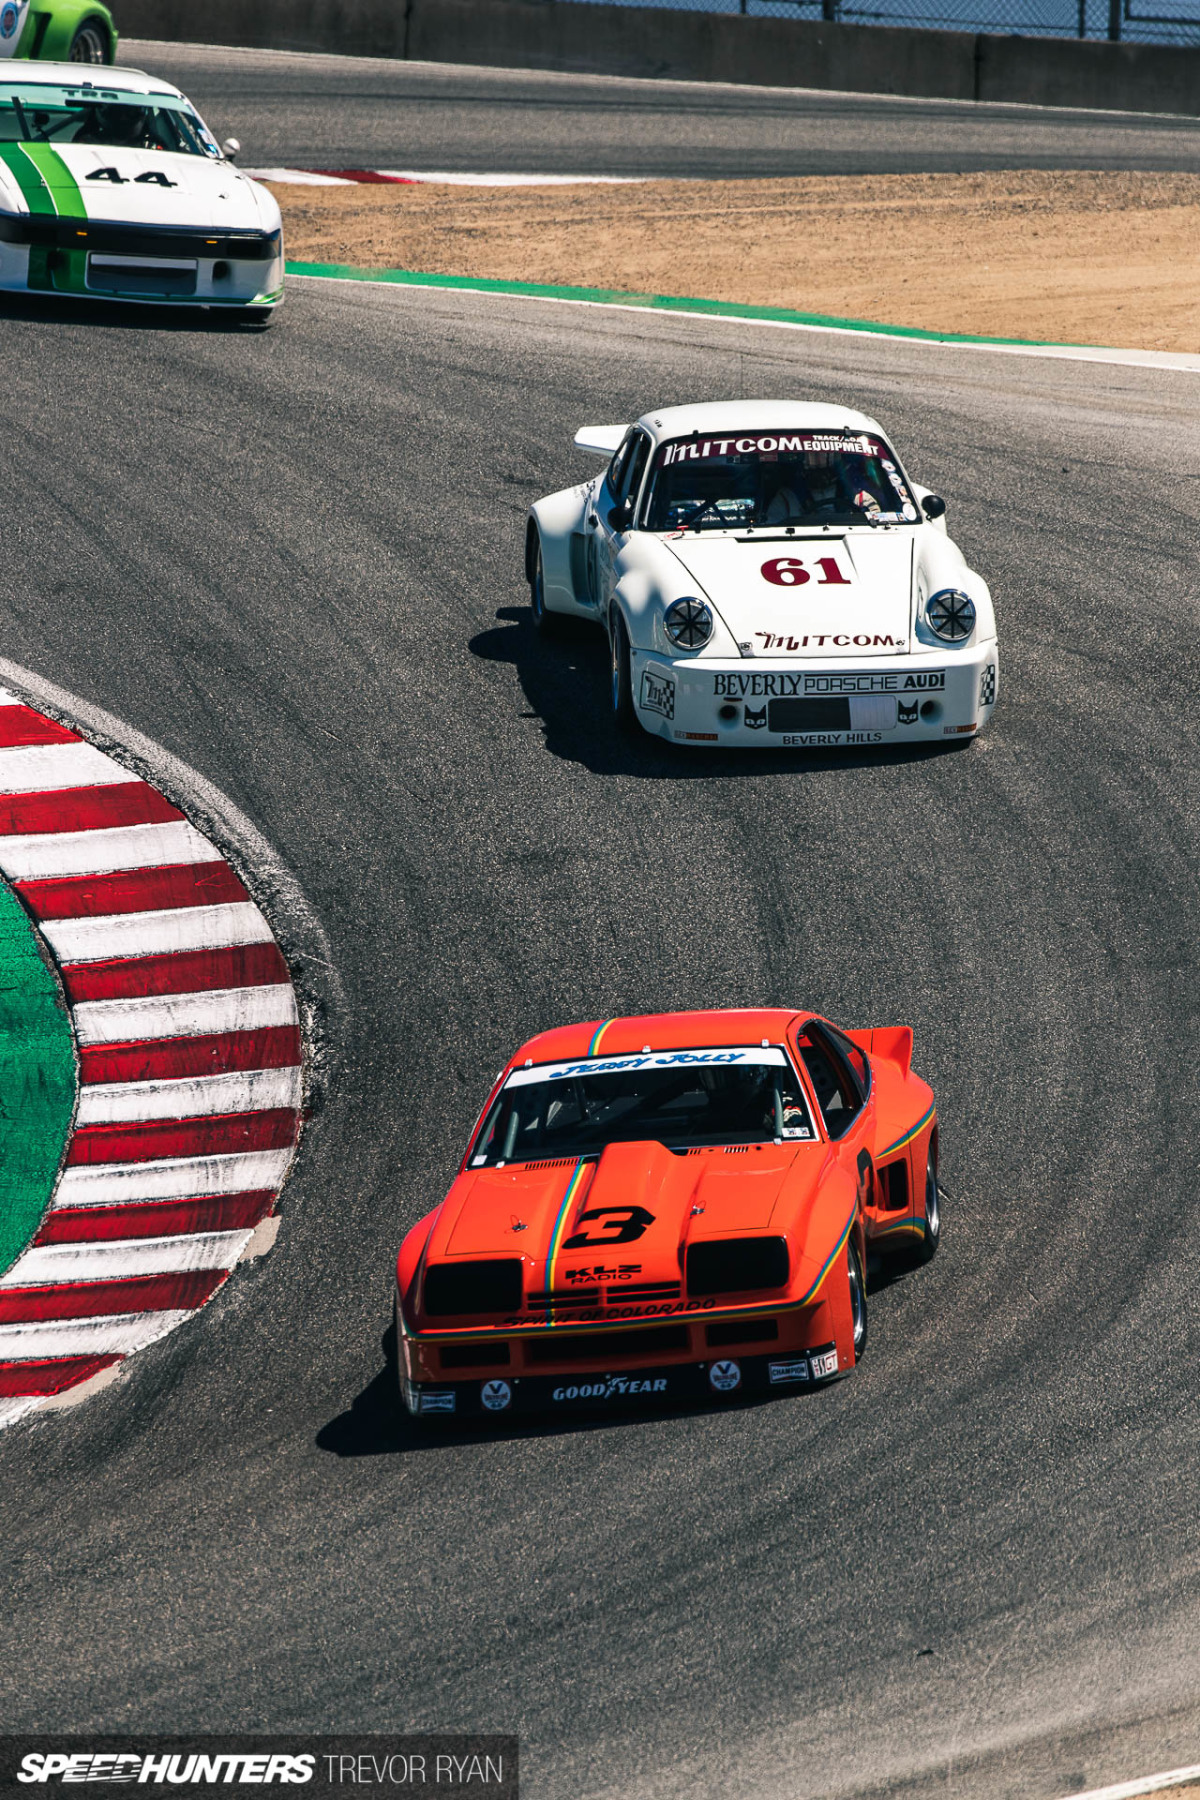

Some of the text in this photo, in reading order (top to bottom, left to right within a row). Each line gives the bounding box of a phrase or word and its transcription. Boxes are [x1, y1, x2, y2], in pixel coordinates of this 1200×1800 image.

[85, 167, 178, 188] 44
[804, 441, 879, 456] EQUIPMENT
[760, 557, 852, 586] 61
[713, 673, 945, 697] BEVERLY PORSCHE AUDI
[782, 732, 882, 745] BEVERLY HILLS
[655, 1053, 746, 1065] JOLLY
[561, 1205, 657, 1250] 3
[564, 1264, 642, 1280] KLZ
[570, 1274, 633, 1285] RADIO
[610, 1299, 717, 1319] COLORADO
